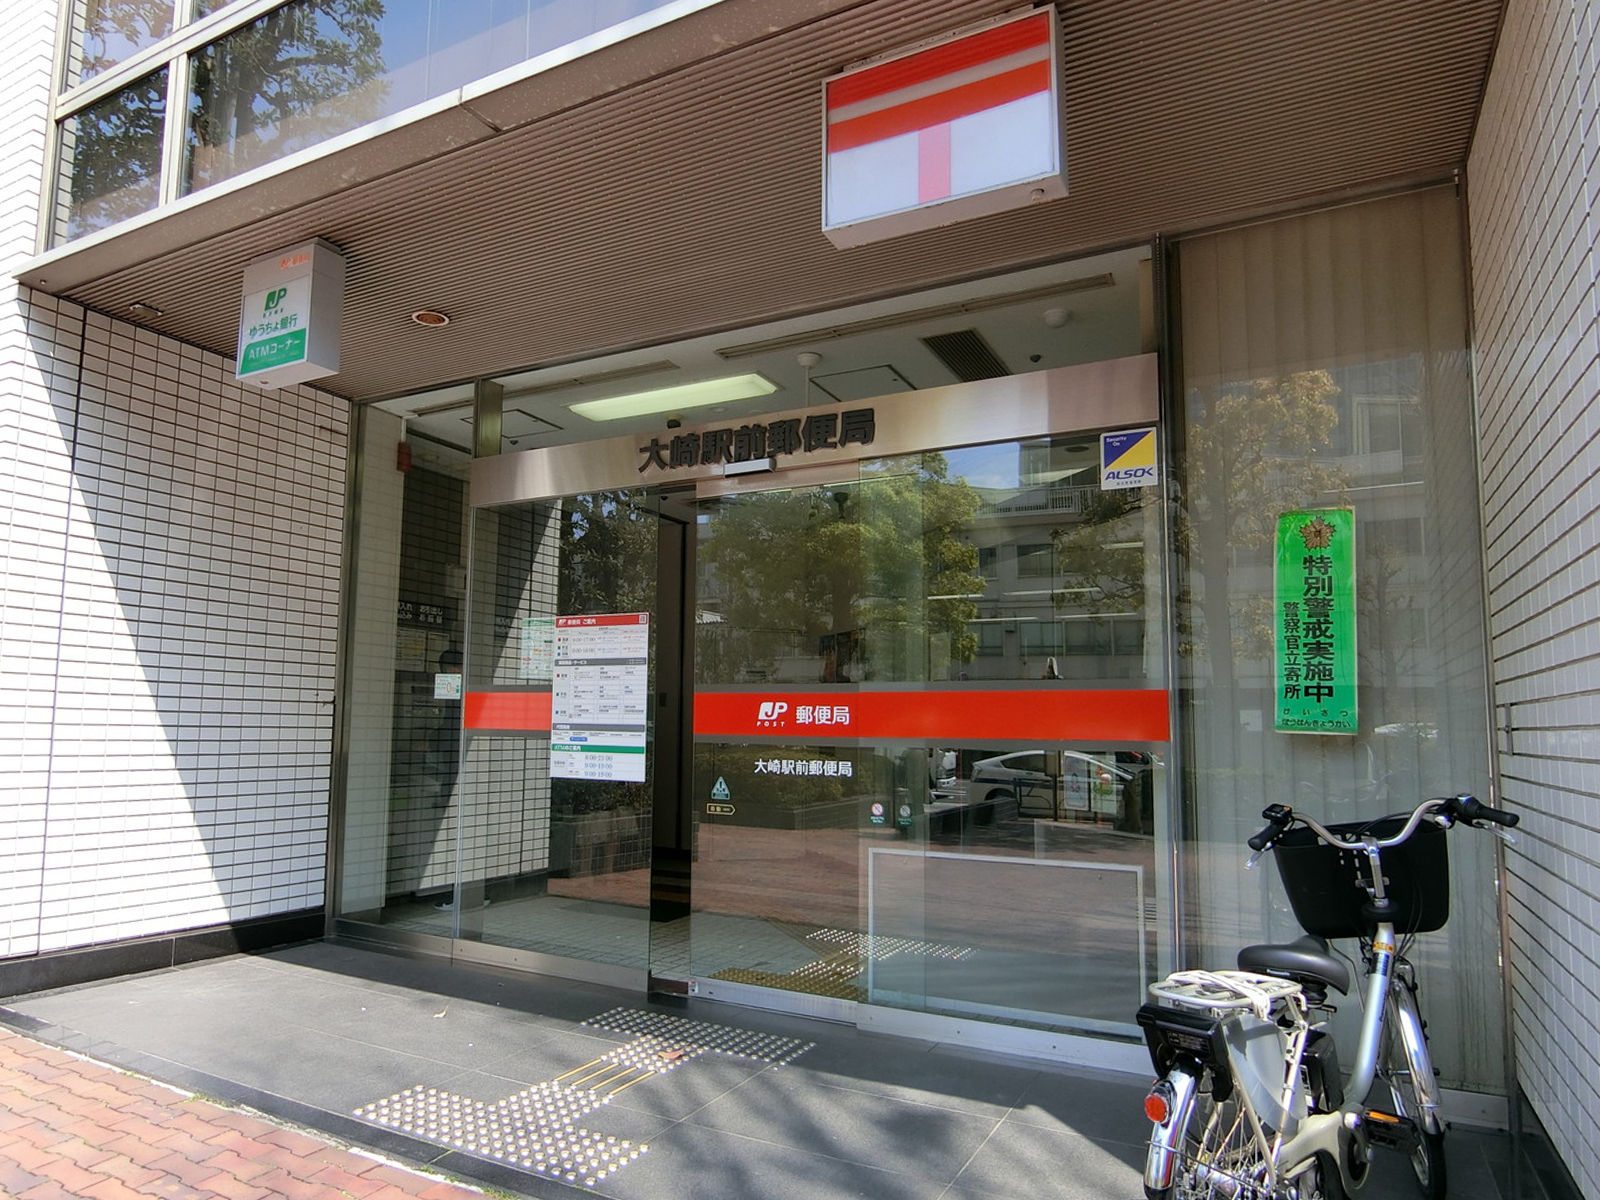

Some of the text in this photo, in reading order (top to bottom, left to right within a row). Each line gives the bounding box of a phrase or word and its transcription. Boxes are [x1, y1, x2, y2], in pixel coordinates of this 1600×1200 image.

[249, 313, 298, 339] ゆうちょ銀行
[249, 339, 301, 360] ATMコーナー
[638, 408, 876, 474] 大崎駅前郵便局
[1105, 467, 1154, 480] ALSOK
[1303, 555, 1334, 703] 特別警戒実施中
[1283, 602, 1301, 699] 警察官立寄所
[796, 705, 850, 725] 郵便局
[754, 758, 852, 777] 大崎駅前郵便局
